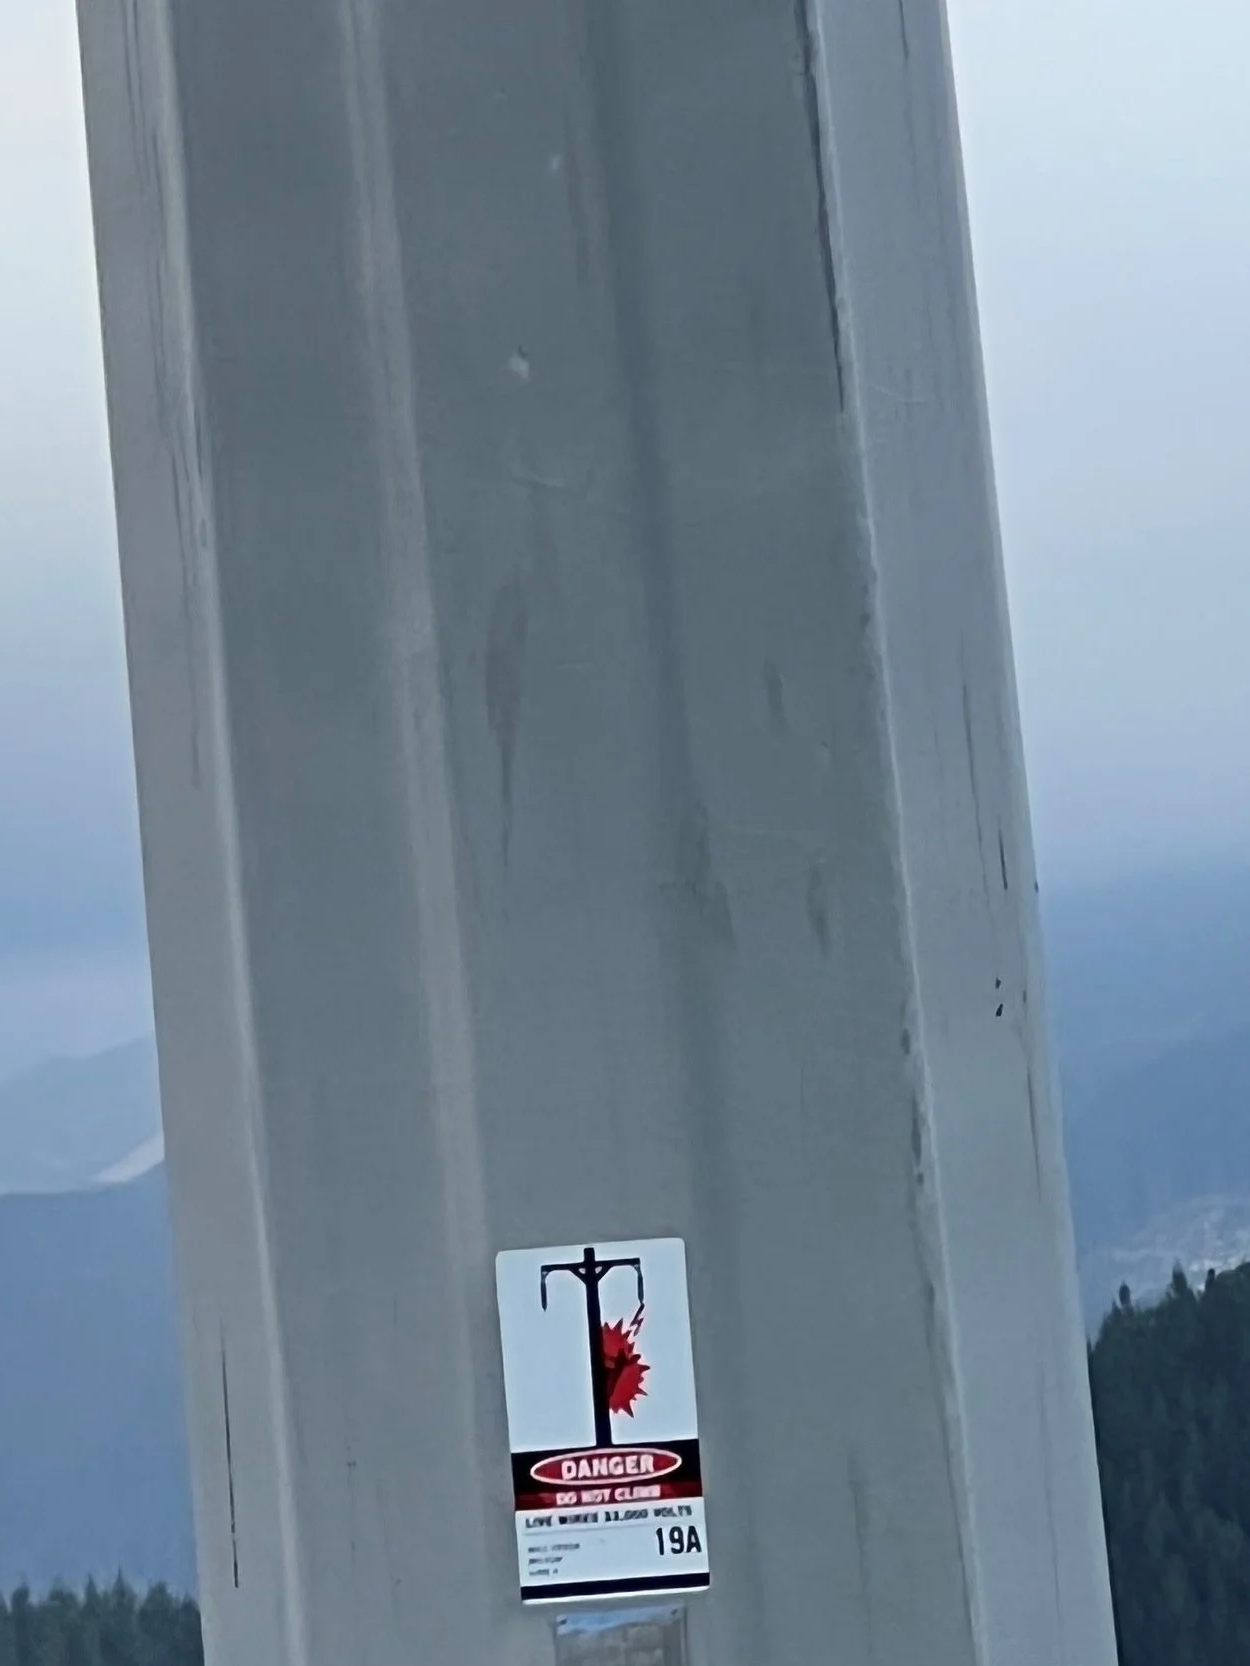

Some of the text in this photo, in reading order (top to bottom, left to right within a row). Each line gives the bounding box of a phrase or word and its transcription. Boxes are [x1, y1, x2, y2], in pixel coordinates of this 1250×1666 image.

[561, 1454, 654, 1480] DANGER
[556, 1491, 577, 1505] DO
[581, 1489, 610, 1503] NOT
[525, 1515, 552, 1528] LIVE
[656, 1525, 702, 1555] 19A
